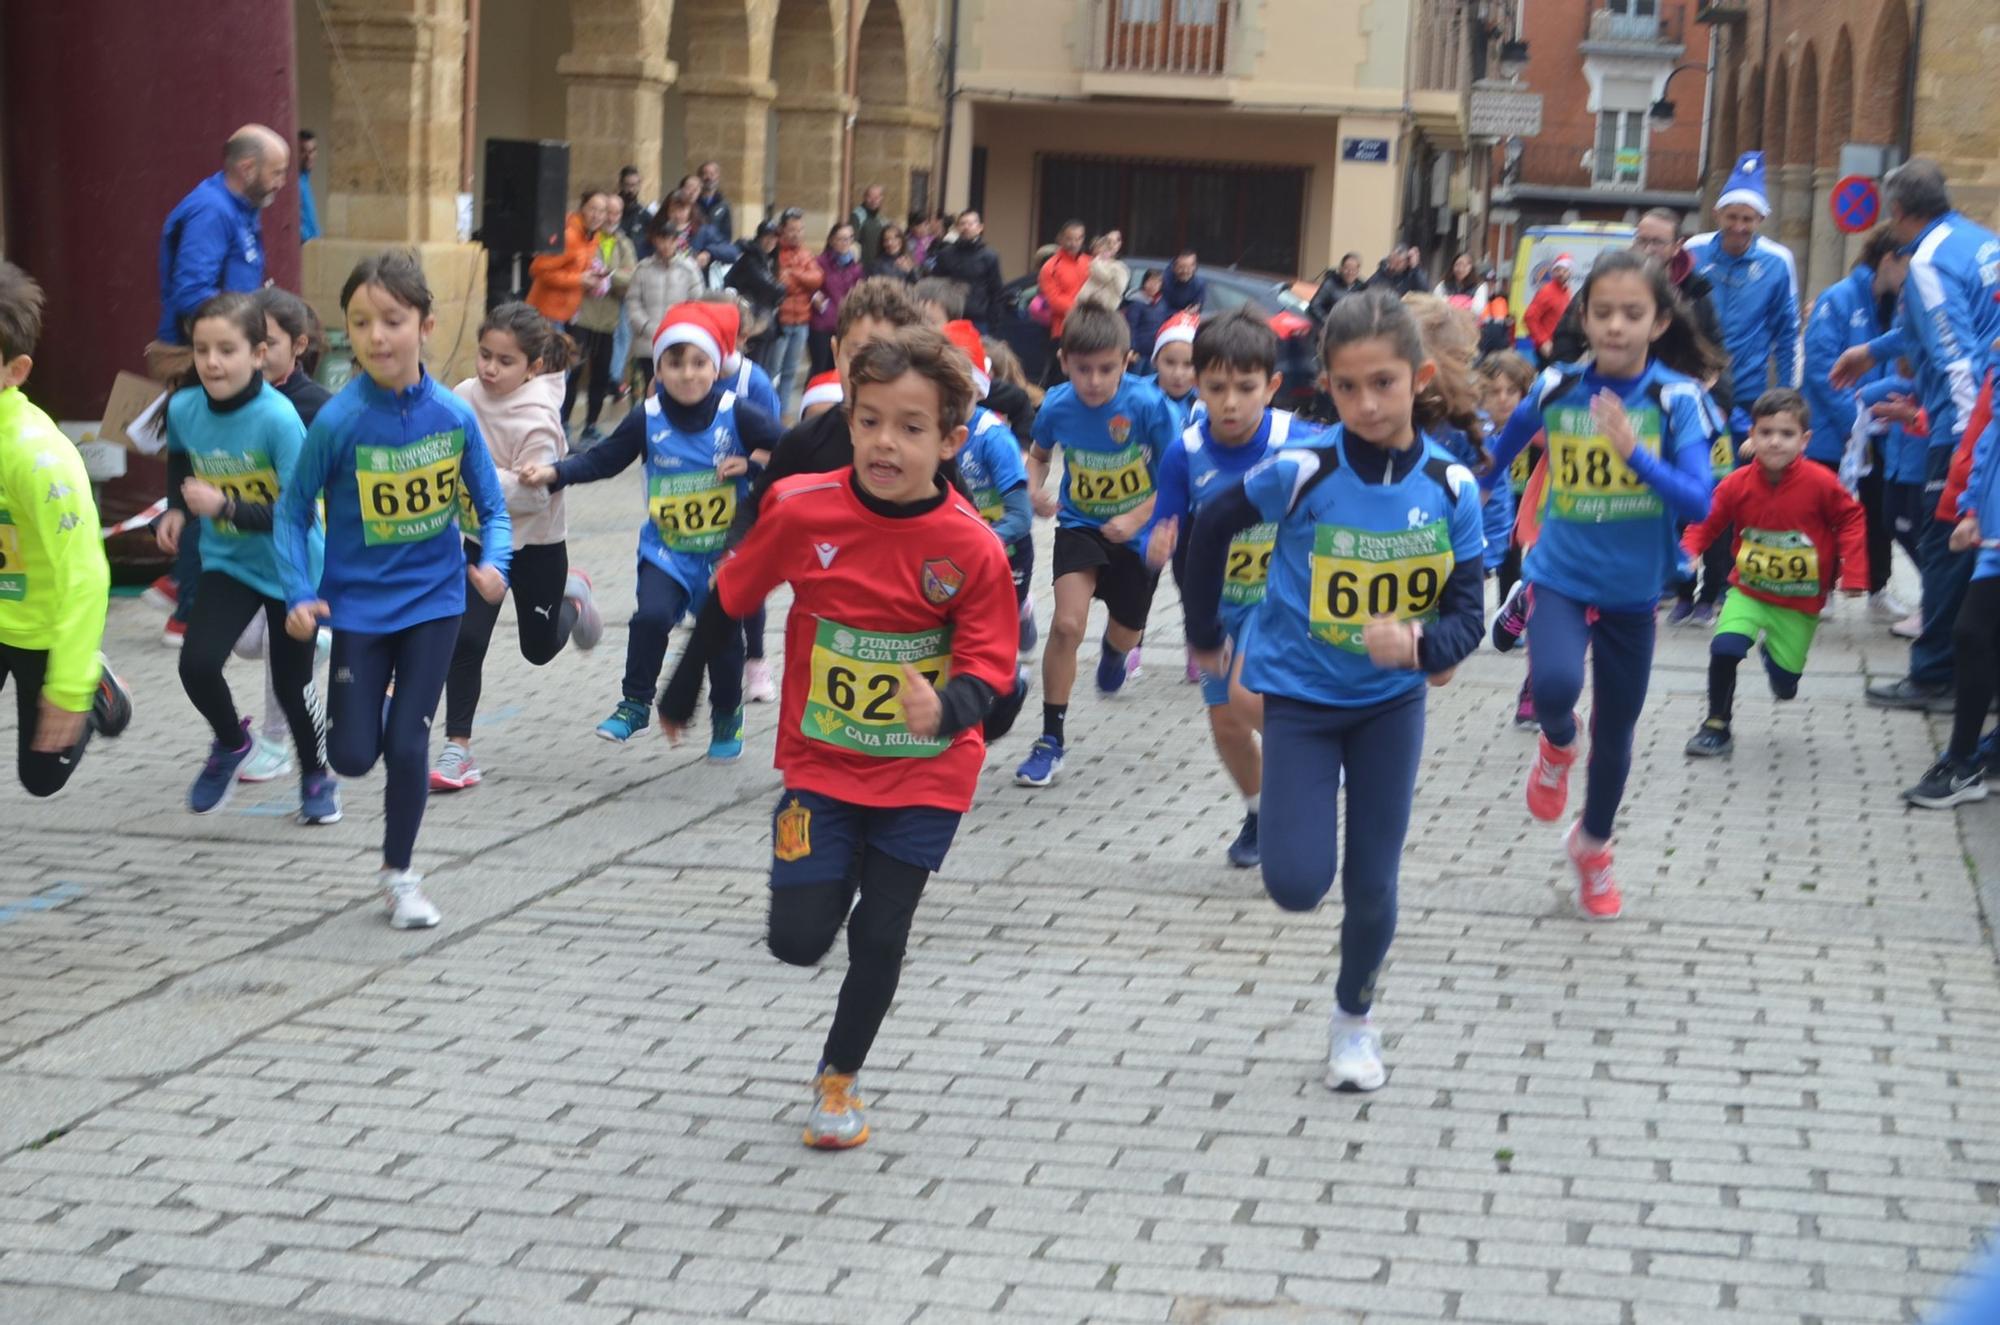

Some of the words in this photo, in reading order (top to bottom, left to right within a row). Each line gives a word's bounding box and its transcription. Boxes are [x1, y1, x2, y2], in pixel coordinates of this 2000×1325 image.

[372, 466, 455, 516] 685
[659, 496, 729, 530] 582
[1745, 549, 1808, 579] 559
[1327, 567, 1438, 619] 609
[857, 649, 892, 661] CAJA
[896, 647, 938, 662] RURAL
[858, 633, 942, 652] FUNDACION
[844, 725, 881, 747] CAJA
[884, 732, 941, 747] RURAL
